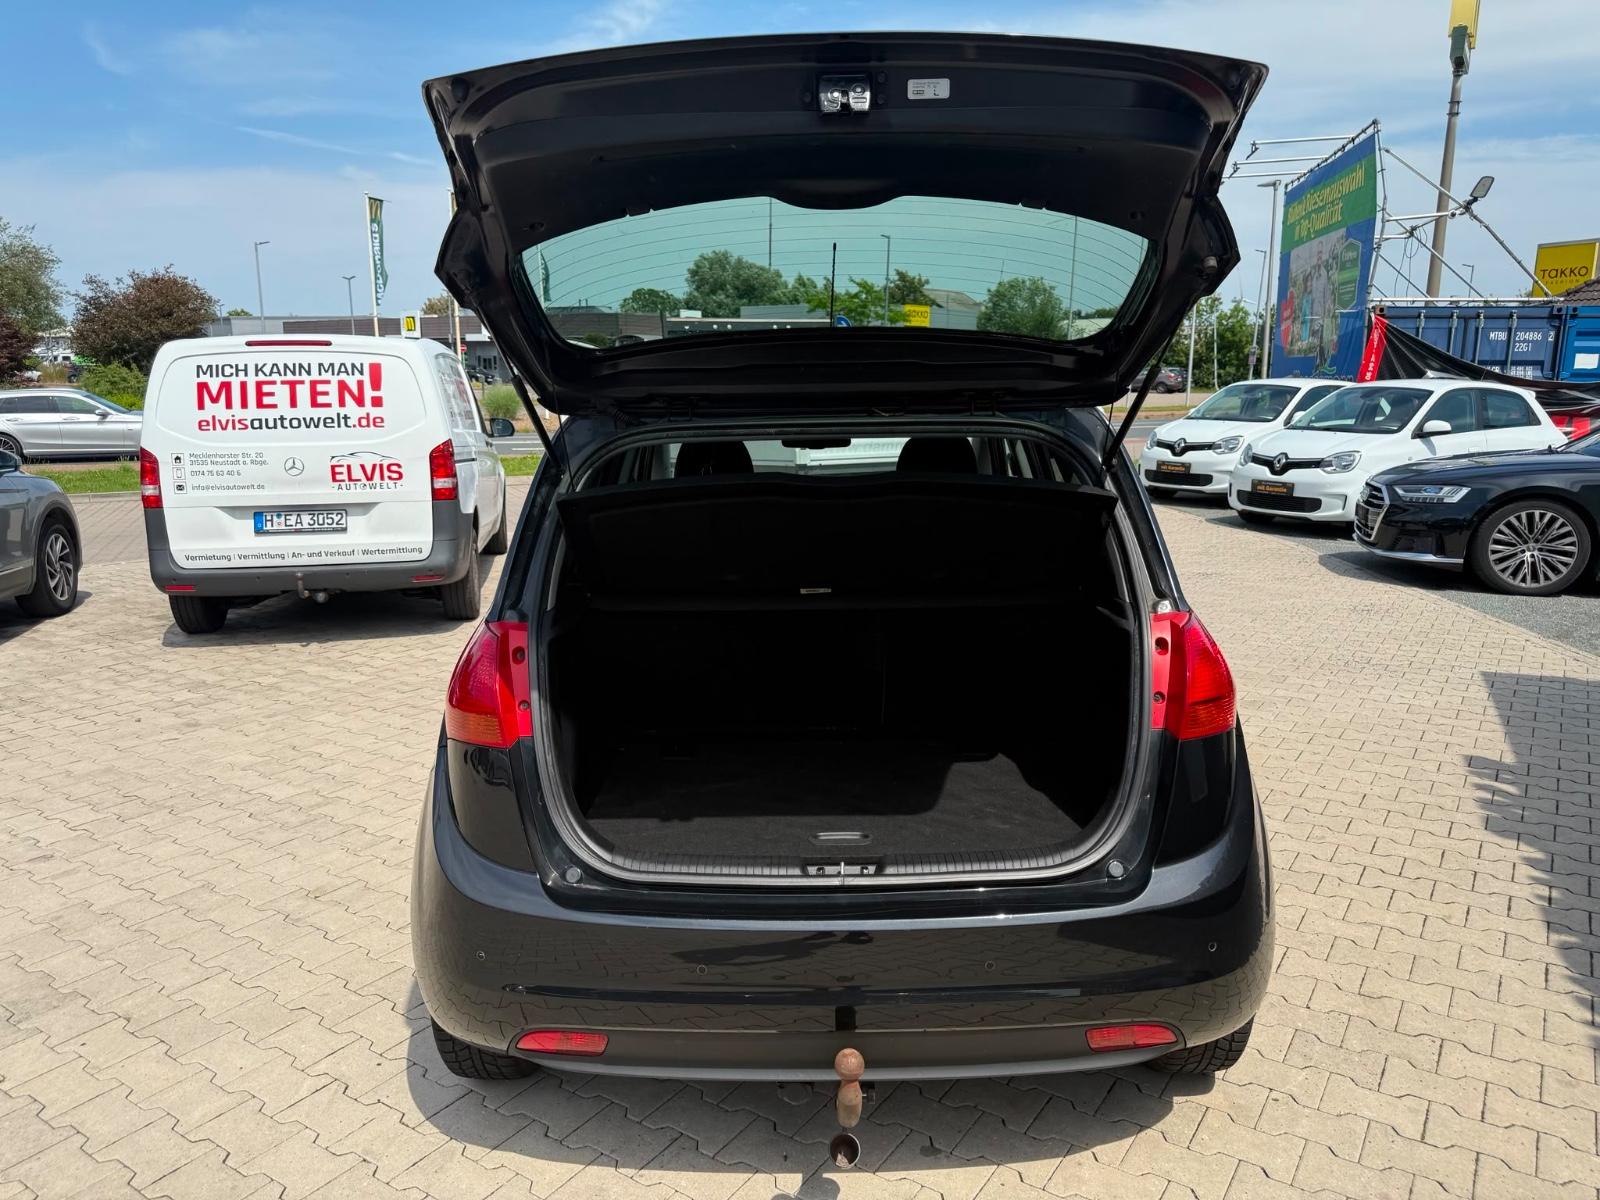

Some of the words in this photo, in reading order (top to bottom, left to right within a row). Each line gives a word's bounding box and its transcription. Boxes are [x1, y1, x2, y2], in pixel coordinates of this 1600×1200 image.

[1489, 331, 1508, 341] MTBU
[1515, 331, 1542, 341] 204886
[1548, 331, 1555, 341] 2
[196, 363, 248, 378] MICH
[254, 362, 312, 377] KANN
[318, 362, 364, 376] MAN
[197, 412, 385, 431] elvisautowelt.de
[189, 452, 240, 460] Mecklenhorster
[250, 459, 269, 467] Rbge.
[330, 463, 404, 483] ELVIS
[264, 513, 274, 528] H
[284, 513, 304, 527] EA
[307, 512, 345, 527] 3052
[184, 554, 232, 562] Vermietung
[237, 552, 285, 561] Vermittlung
[307, 550, 322, 558] und
[323, 549, 355, 557] Verkauf
[361, 546, 423, 556] Wertermittlung
